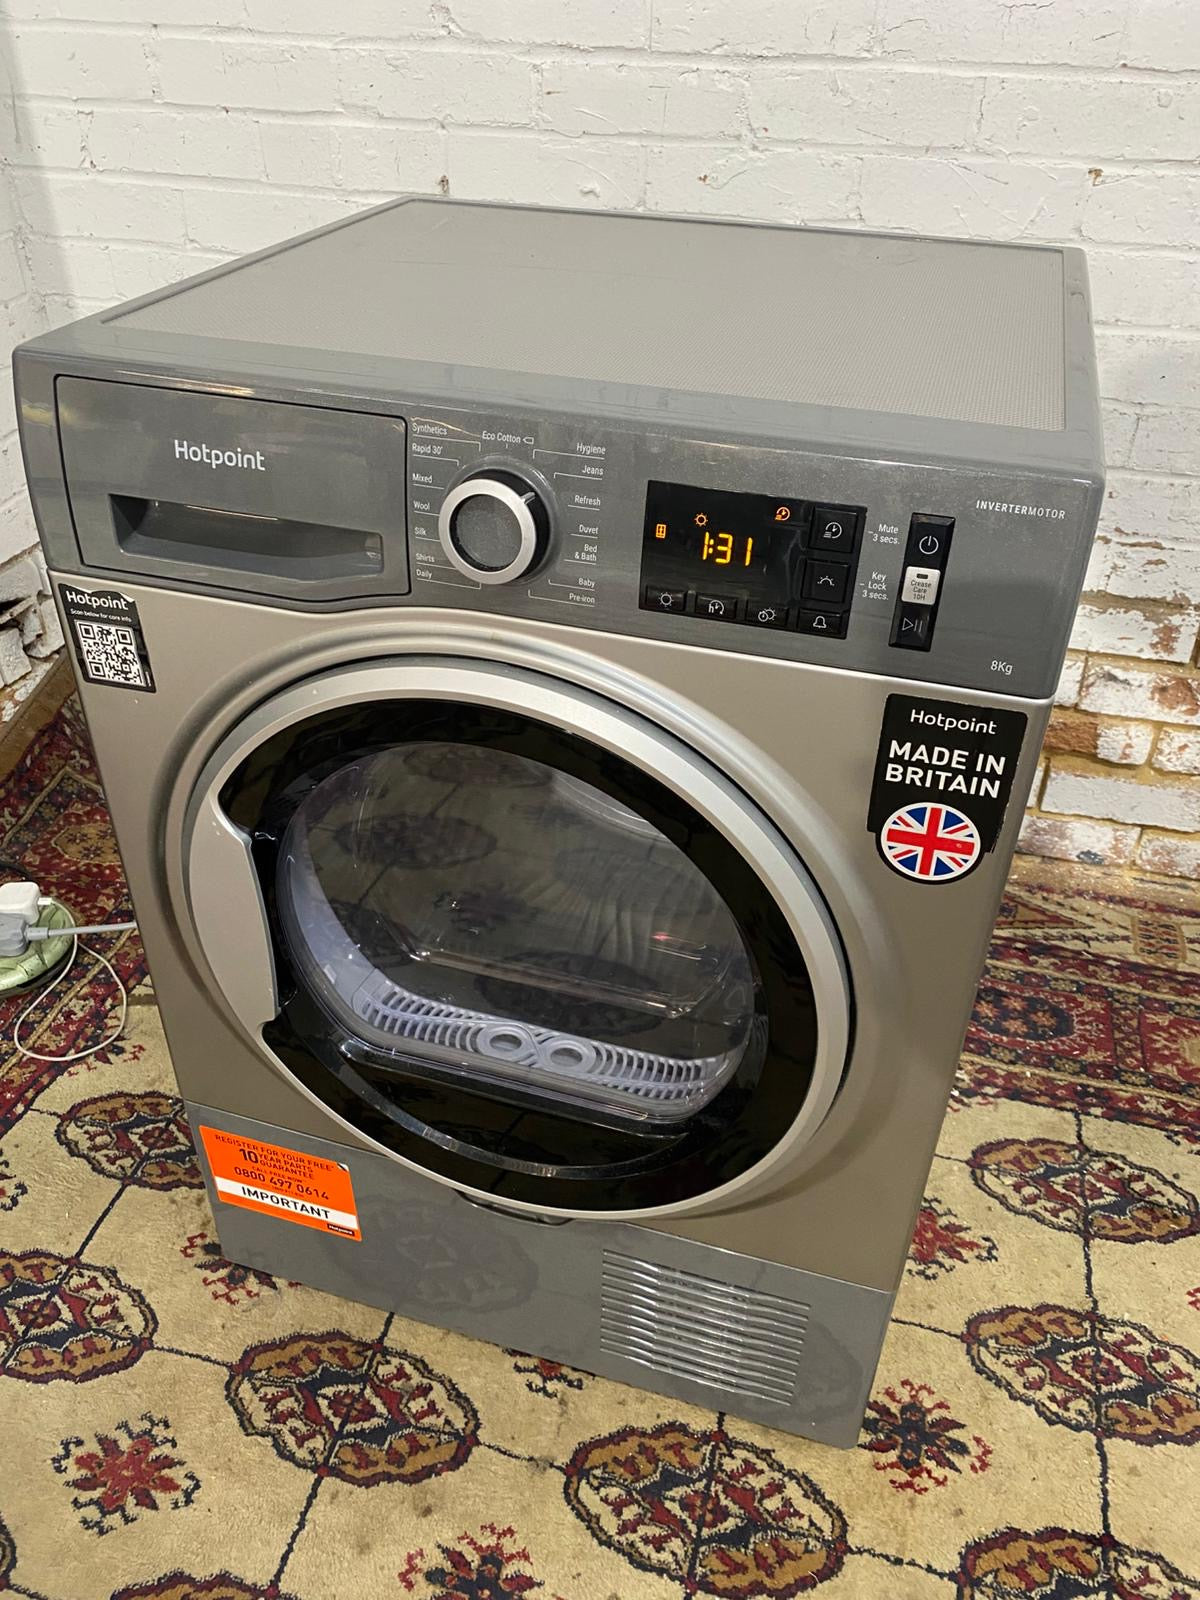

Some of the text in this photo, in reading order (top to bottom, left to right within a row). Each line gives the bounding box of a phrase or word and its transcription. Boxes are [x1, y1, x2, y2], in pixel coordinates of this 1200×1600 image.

[411, 422, 448, 435] Synthetics
[482, 430, 521, 444] Eco Cotton
[411, 442, 431, 454] Rapid
[576, 443, 606, 455] Hygiene
[174, 439, 266, 471] Hotpoint
[581, 465, 604, 475] Jeans
[412, 473, 433, 484] Mixed
[413, 500, 431, 511] Wool
[574, 494, 601, 506] Refresh
[975, 499, 1066, 519] INVERTERMOTOR
[414, 526, 427, 536] Silk
[578, 524, 599, 535] Duvet
[878, 523, 899, 534] Mute
[872, 533, 900, 545] 3 secs.
[583, 543, 598, 553] Bed
[702, 531, 754, 567] 1:31
[415, 552, 436, 564] Shirts
[574, 551, 597, 562] & Bath
[416, 568, 433, 579] Daily
[871, 571, 886, 582] Key
[578, 577, 595, 588] Baby
[868, 581, 887, 591] Lock
[910, 580, 932, 588] Crease
[862, 589, 889, 601] 3 secs.
[913, 586, 927, 594] Care
[66, 590, 129, 610] Hotpoint
[569, 592, 596, 604] Pre-iron
[990, 660, 1013, 675] 8Kg
[910, 709, 998, 735] Hotpoint
[889, 739, 1006, 776] MADE IN
[885, 762, 1001, 799] BRITAIN
[215, 1134, 258, 1151] REGISTER
[260, 1146, 279, 1157] FOR
[281, 1152, 305, 1164] YOUR
[239, 1148, 314, 1173] 10 YEAR PARTS
[260, 1160, 314, 1180] GUARANTEE
[234, 1166, 266, 1183] 0800
[269, 1176, 292, 1190] 497
[296, 1183, 330, 1200] 0614
[241, 1186, 331, 1220] IMPORTANT
